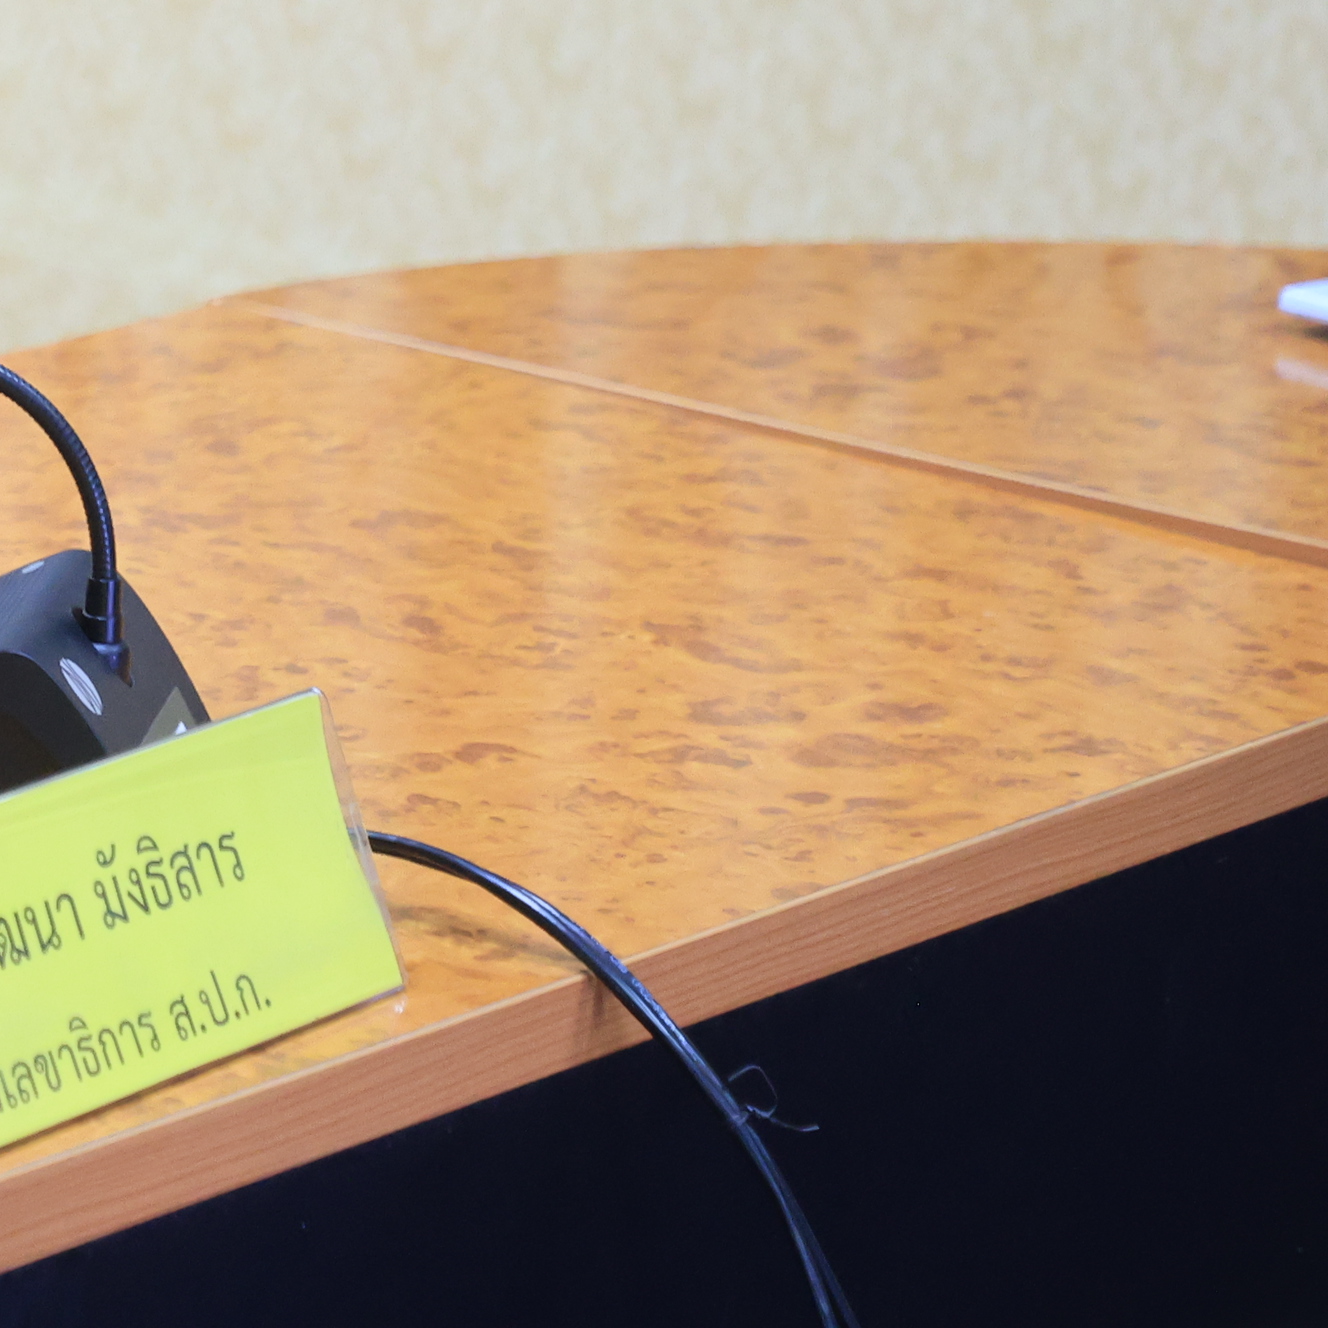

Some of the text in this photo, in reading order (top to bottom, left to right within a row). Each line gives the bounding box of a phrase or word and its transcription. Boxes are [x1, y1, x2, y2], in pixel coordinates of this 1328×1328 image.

[93, 831, 246, 930] มังธิสาร
[169, 969, 272, 1042] ส.ป.ก.
